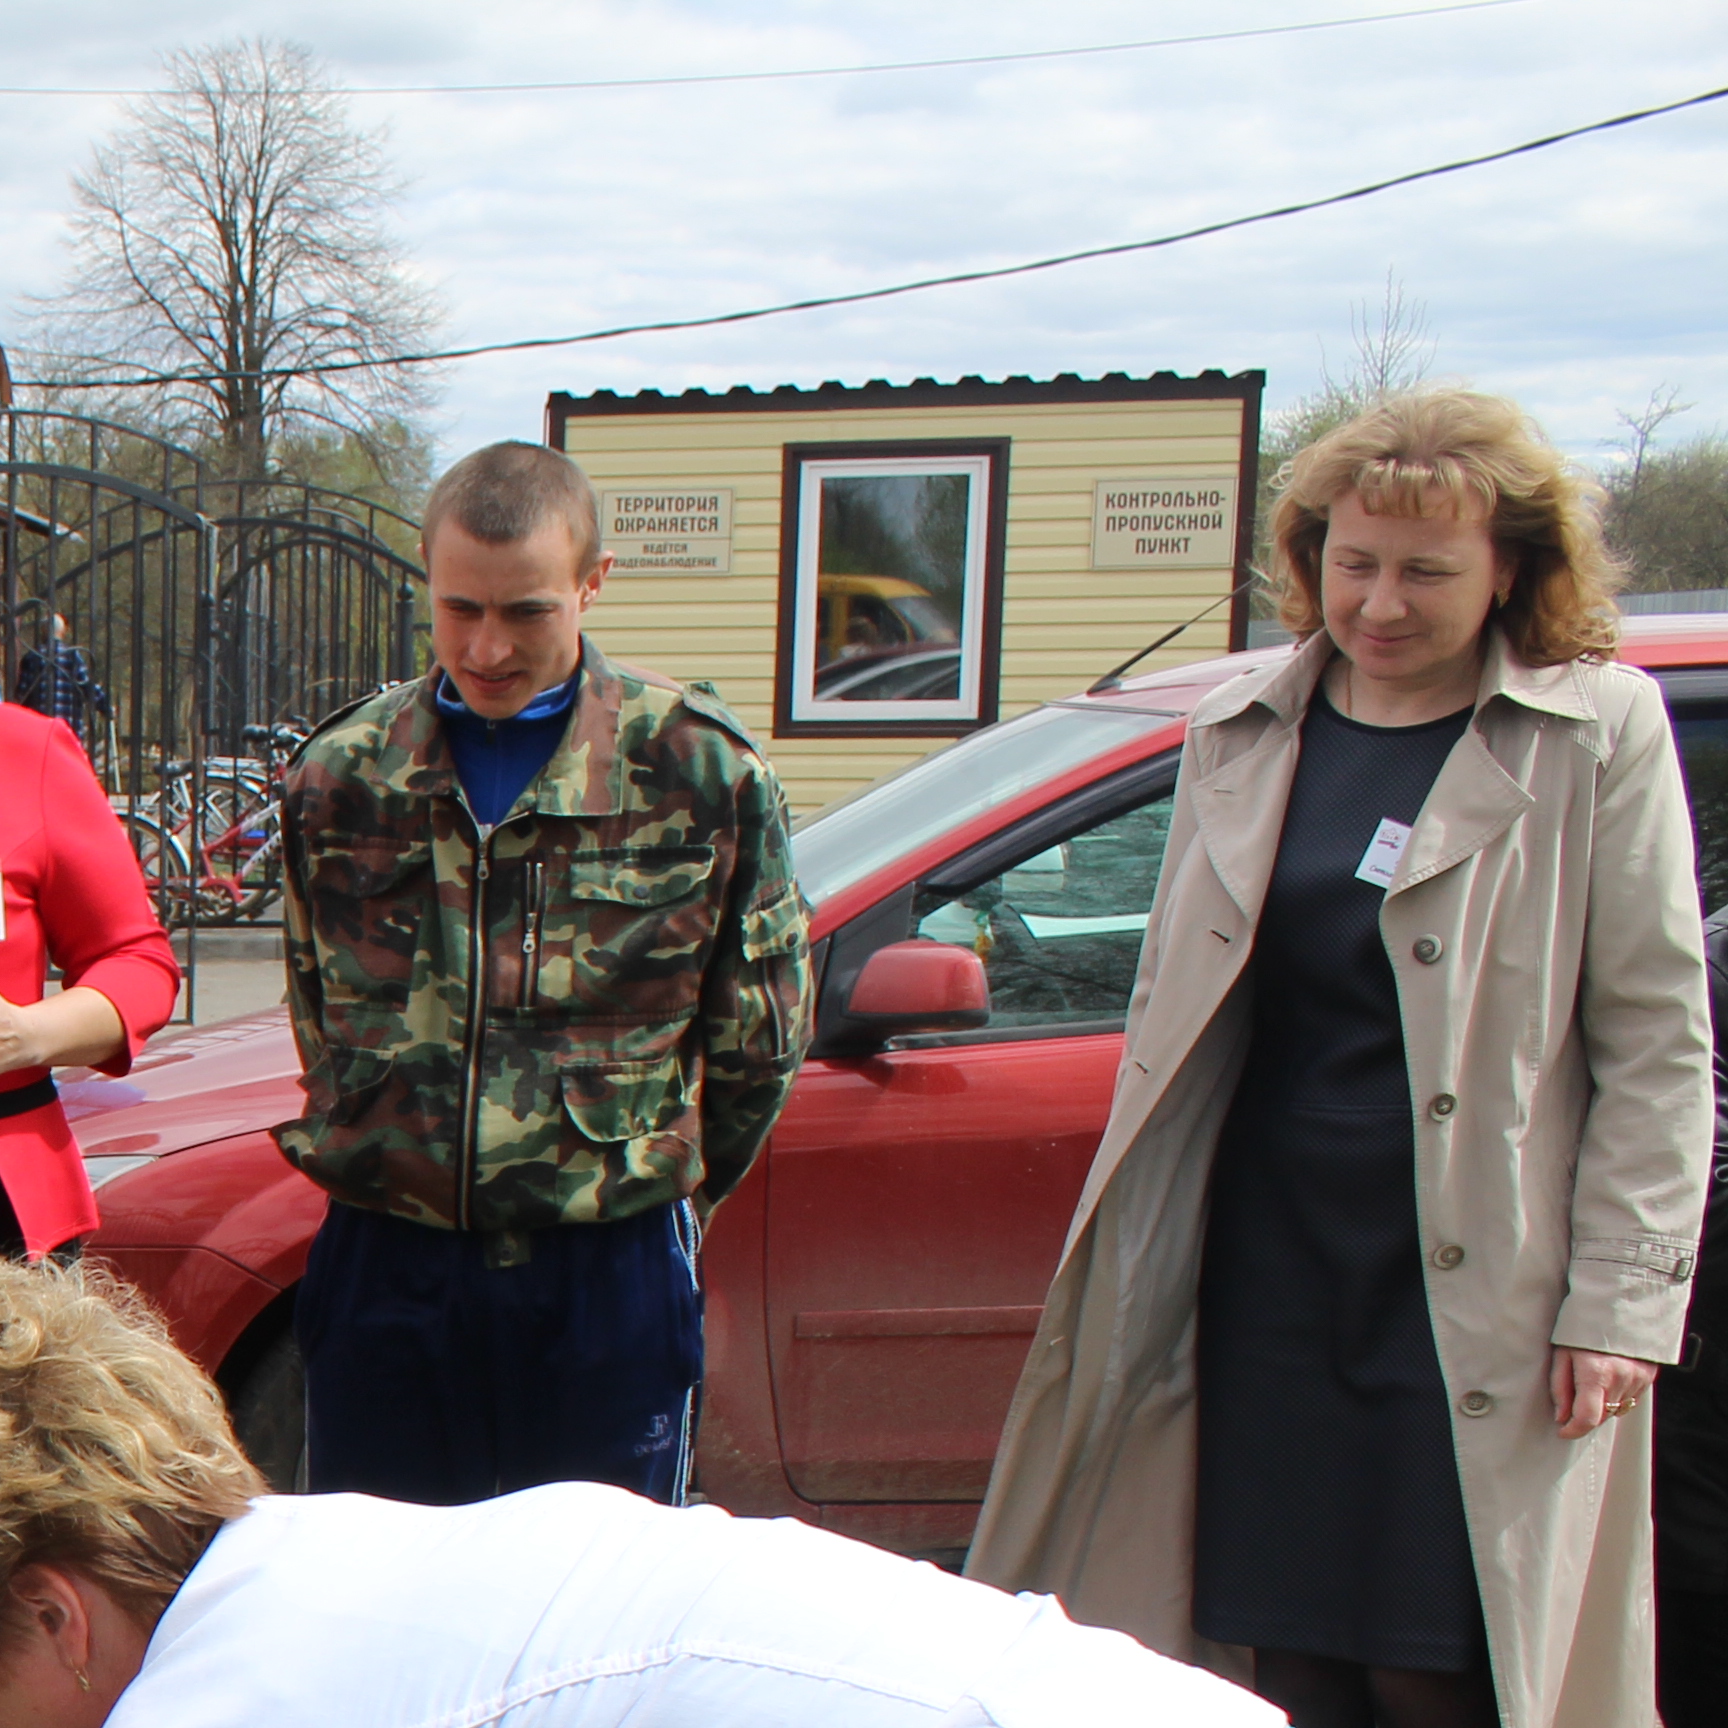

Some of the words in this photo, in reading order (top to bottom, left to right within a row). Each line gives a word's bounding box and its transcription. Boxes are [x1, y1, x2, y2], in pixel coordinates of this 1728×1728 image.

[615, 496, 719, 513] ТЕРРИТОРИЯ
[1105, 490, 1227, 509] КОНТРОЛЬНО-
[614, 516, 719, 533] ОХРАНЯЕТСЯ
[1105, 511, 1223, 532] ПРОПУСКНОЙ
[1135, 537, 1191, 554] ПУНКТ
